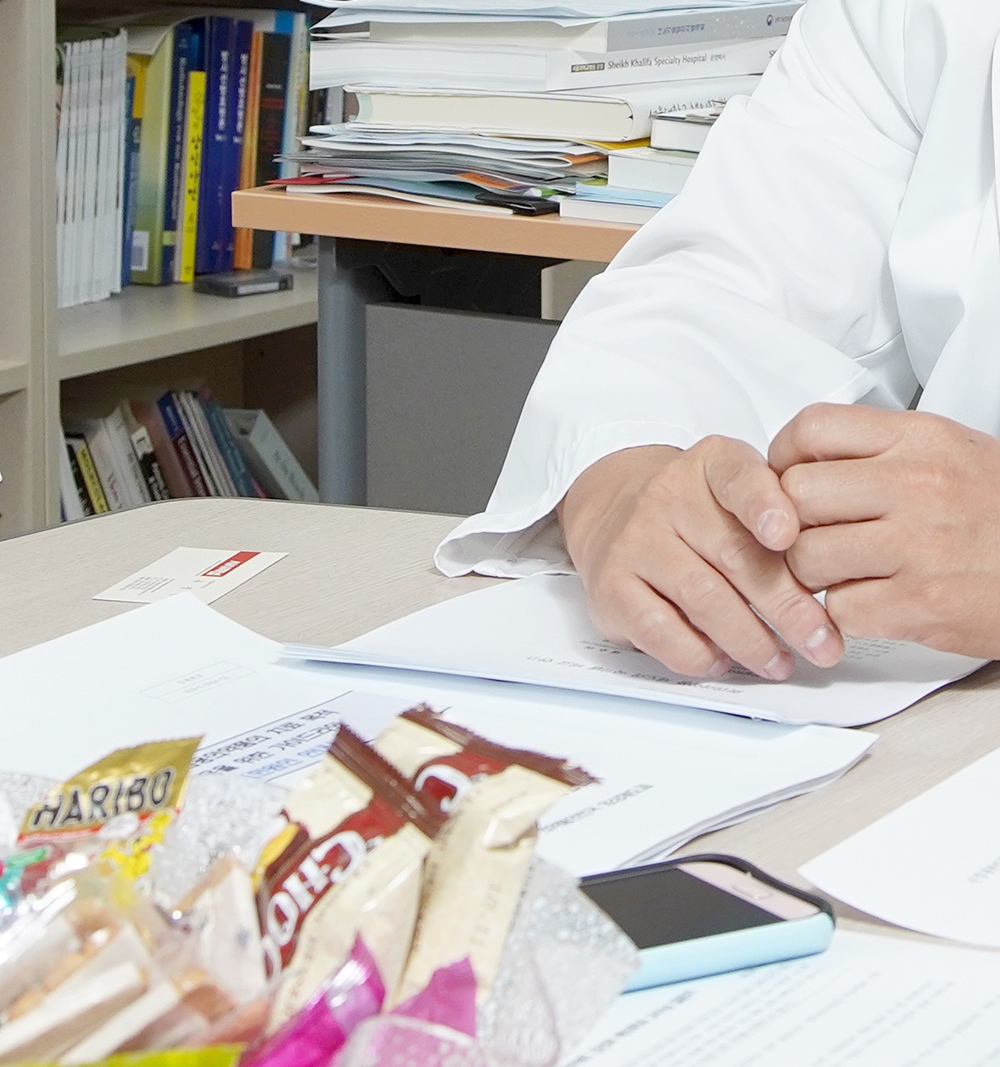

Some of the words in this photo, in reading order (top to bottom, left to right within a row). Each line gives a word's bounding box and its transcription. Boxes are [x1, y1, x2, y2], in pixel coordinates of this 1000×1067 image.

[608, 60, 629, 70] Sheikh
[631, 57, 652, 68] Khalifa
[654, 55, 681, 67] Specialty
[682, 53, 707, 65] Hospital
[31, 769, 173, 827] HARIBO
